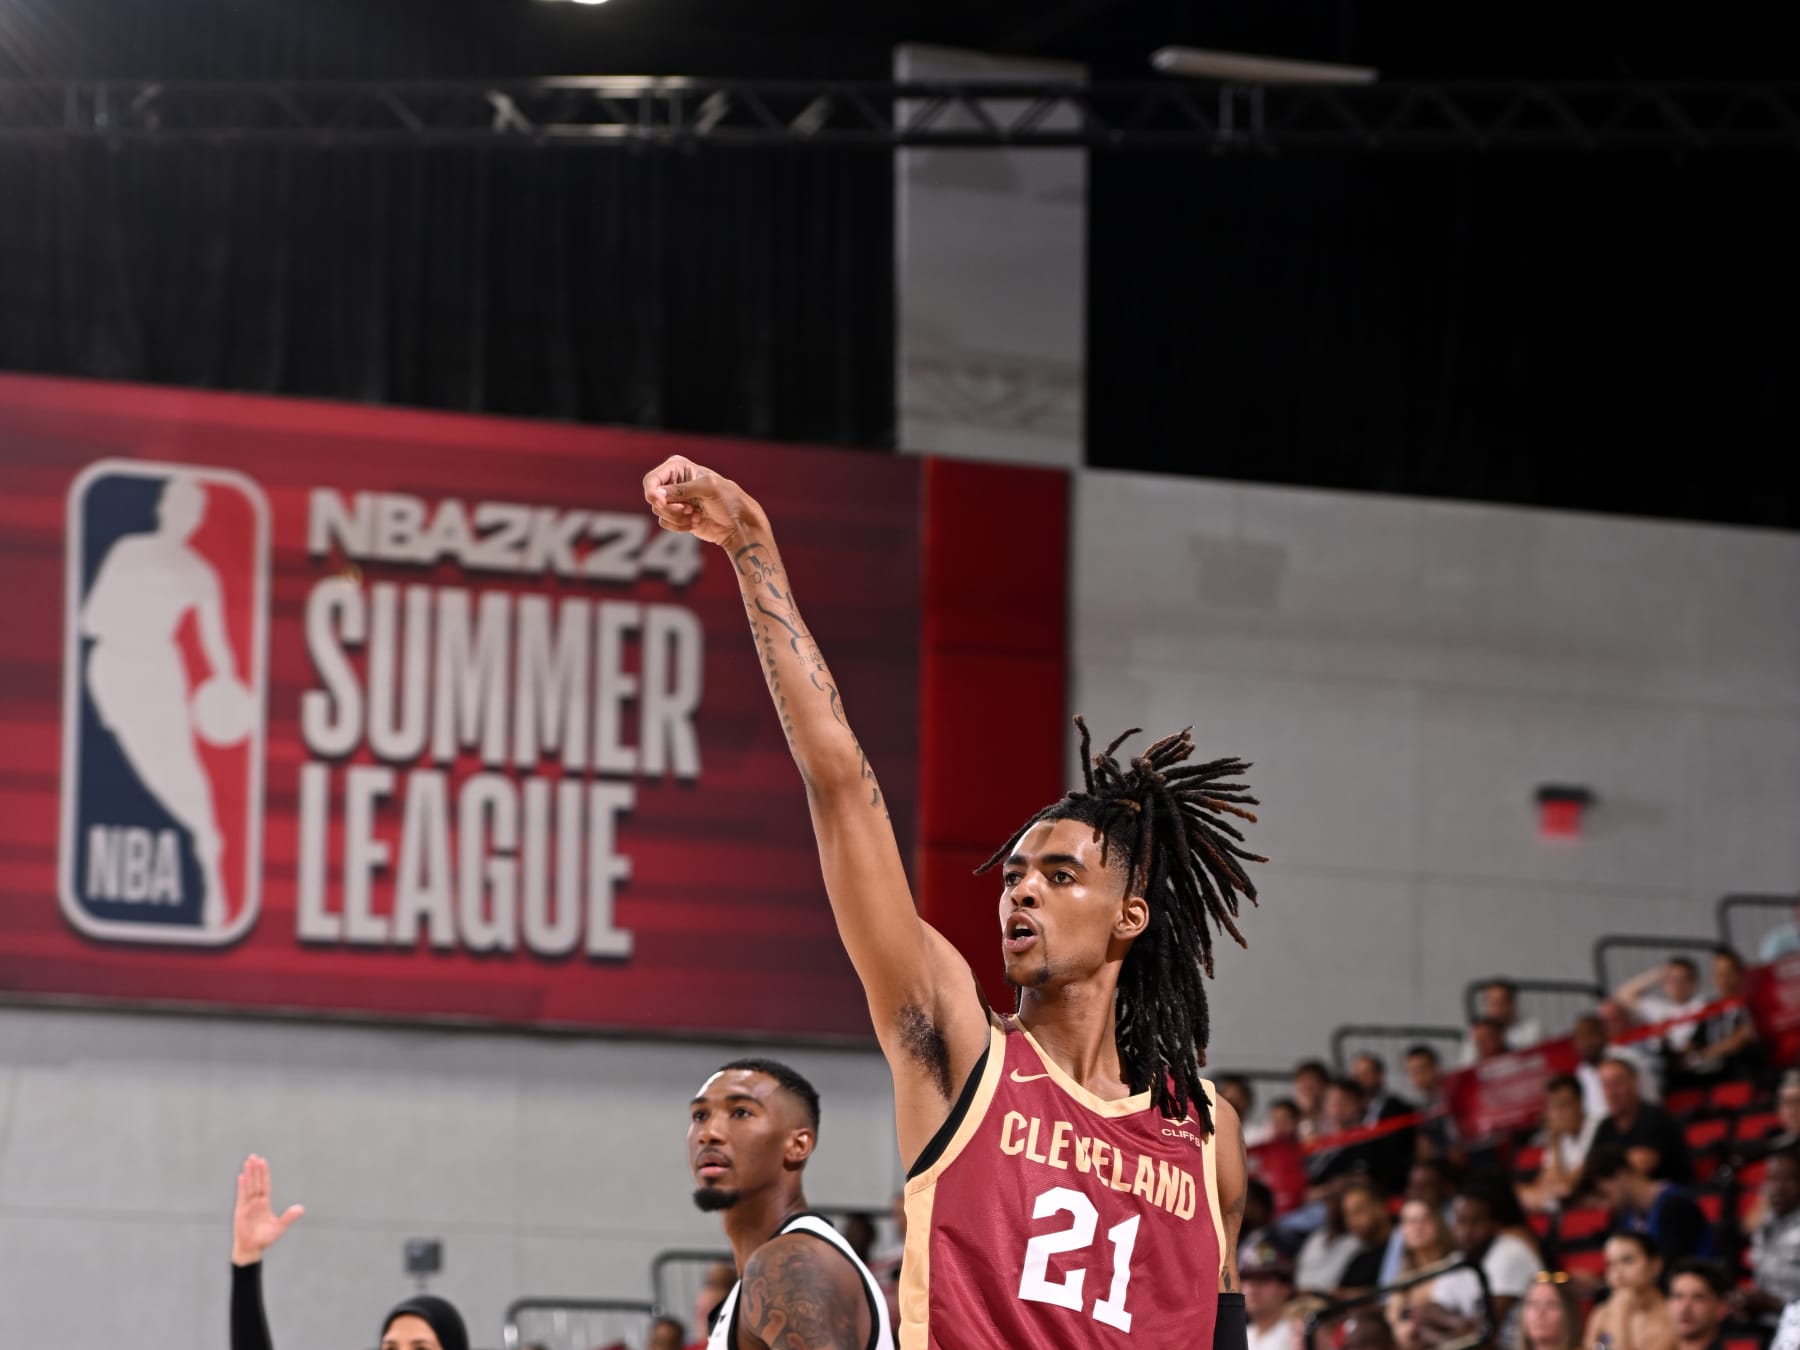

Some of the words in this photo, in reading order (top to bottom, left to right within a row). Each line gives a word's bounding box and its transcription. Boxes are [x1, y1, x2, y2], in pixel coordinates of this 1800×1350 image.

[308, 488, 705, 584] NBA2K24
[304, 576, 704, 777] SUMMER
[87, 826, 184, 903] NBA
[296, 763, 636, 958] LEAGUE
[1000, 1110, 1196, 1221] CLEVELAND
[1161, 1128, 1201, 1147] CLIFFS
[1018, 1186, 1141, 1334] 21
